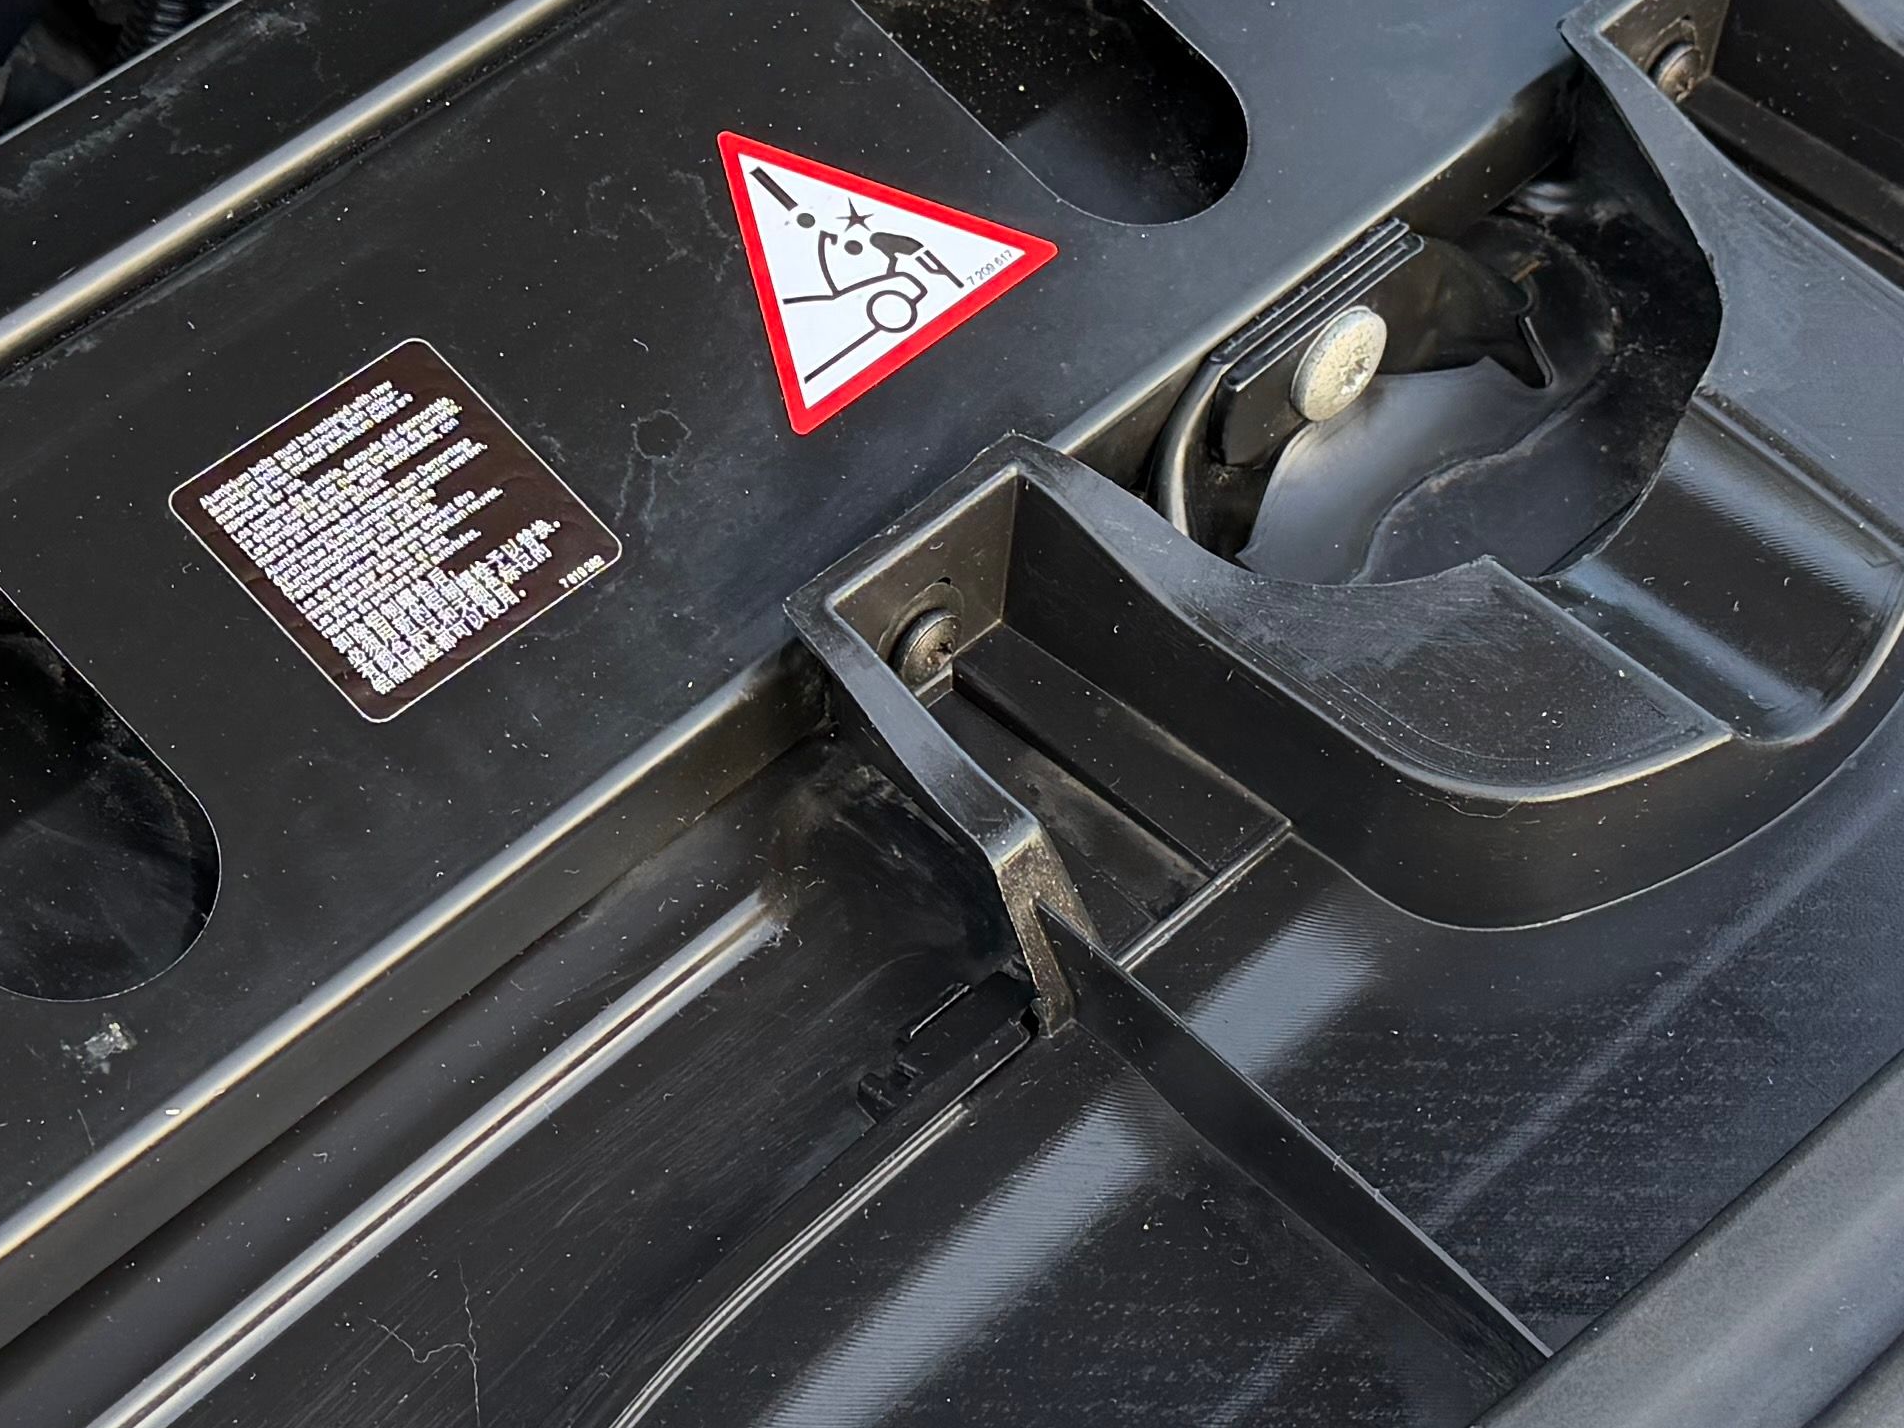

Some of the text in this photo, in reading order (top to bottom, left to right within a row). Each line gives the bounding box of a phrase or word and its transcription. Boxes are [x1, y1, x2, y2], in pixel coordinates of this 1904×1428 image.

[200, 472, 251, 509] Aluminium
[248, 457, 275, 477] bolts
[274, 440, 300, 460] must
[350, 394, 373, 413] with
